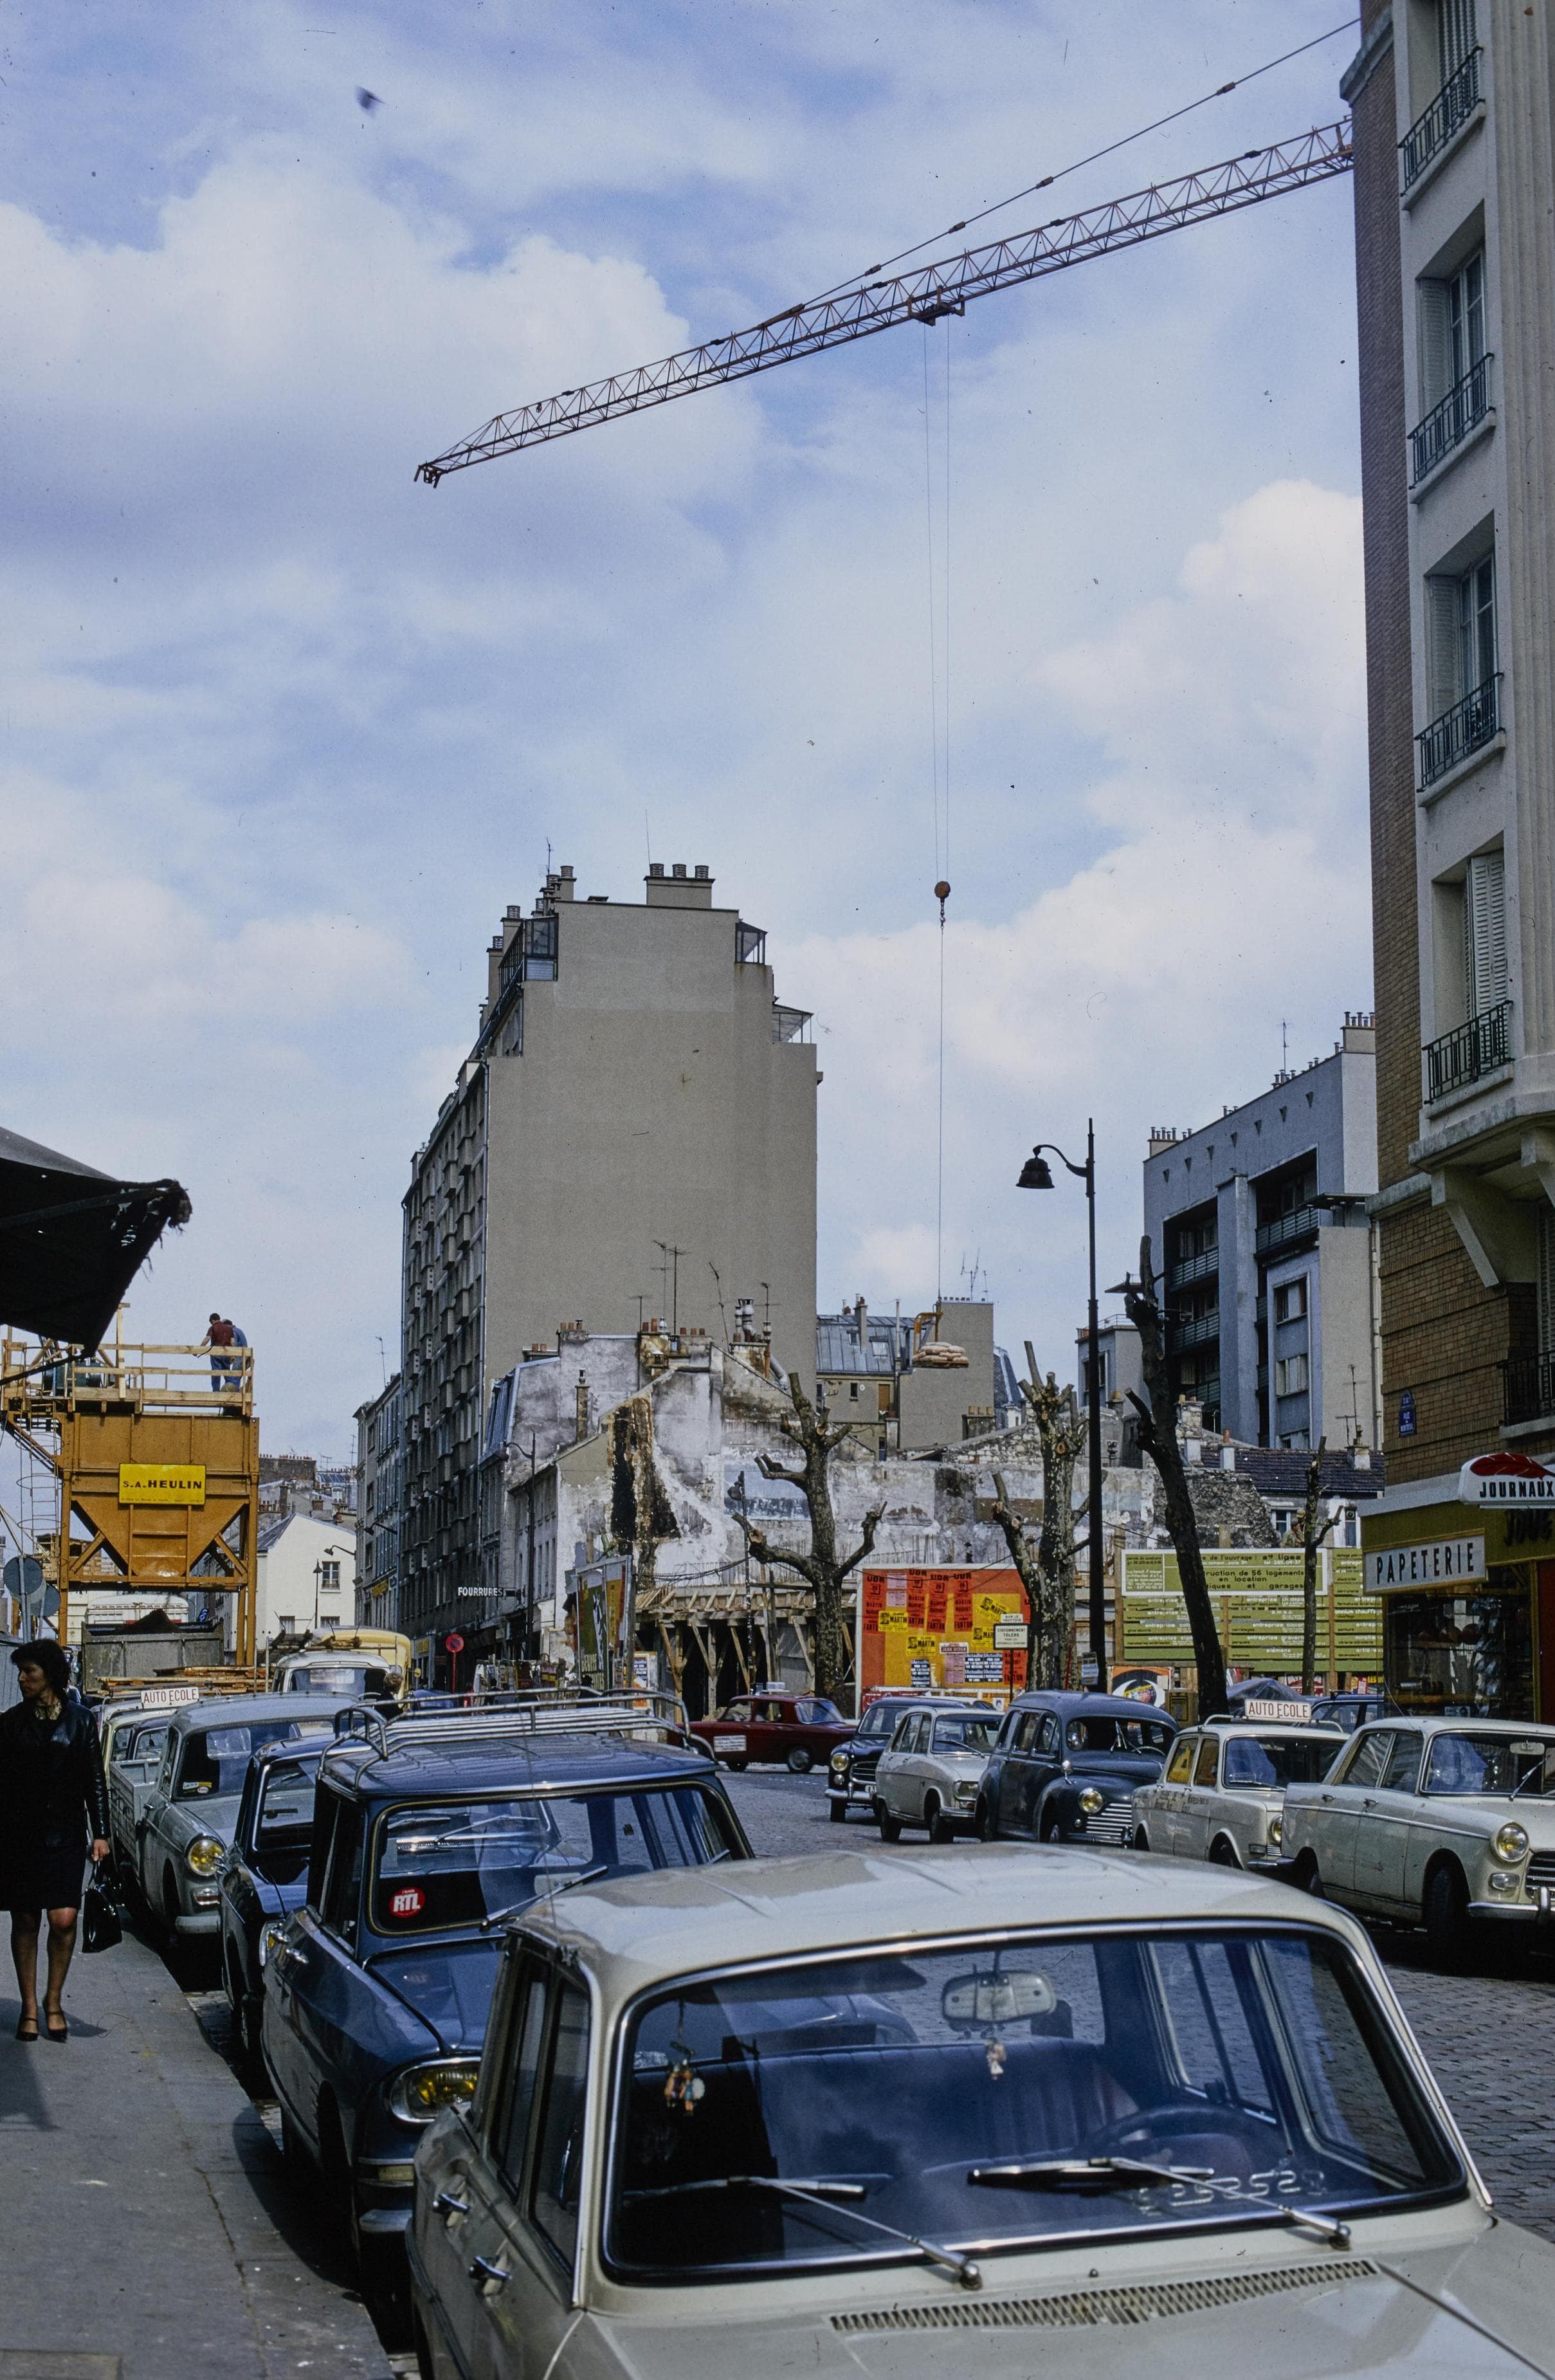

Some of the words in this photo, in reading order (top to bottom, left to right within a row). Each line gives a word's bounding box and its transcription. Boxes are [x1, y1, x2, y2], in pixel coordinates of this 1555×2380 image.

[1479, 1481, 1554, 1498] JOURNAUX
[1376, 1542, 1474, 1584] PAPETERIE
[457, 1586, 503, 1597] FOURRURES
[143, 1691, 167, 1703] AUTO
[169, 1689, 197, 1702] ECOLE
[1248, 1701, 1274, 1716] AUTO
[1277, 1703, 1308, 1717] ECOLE
[393, 1893, 421, 1912] RTL
